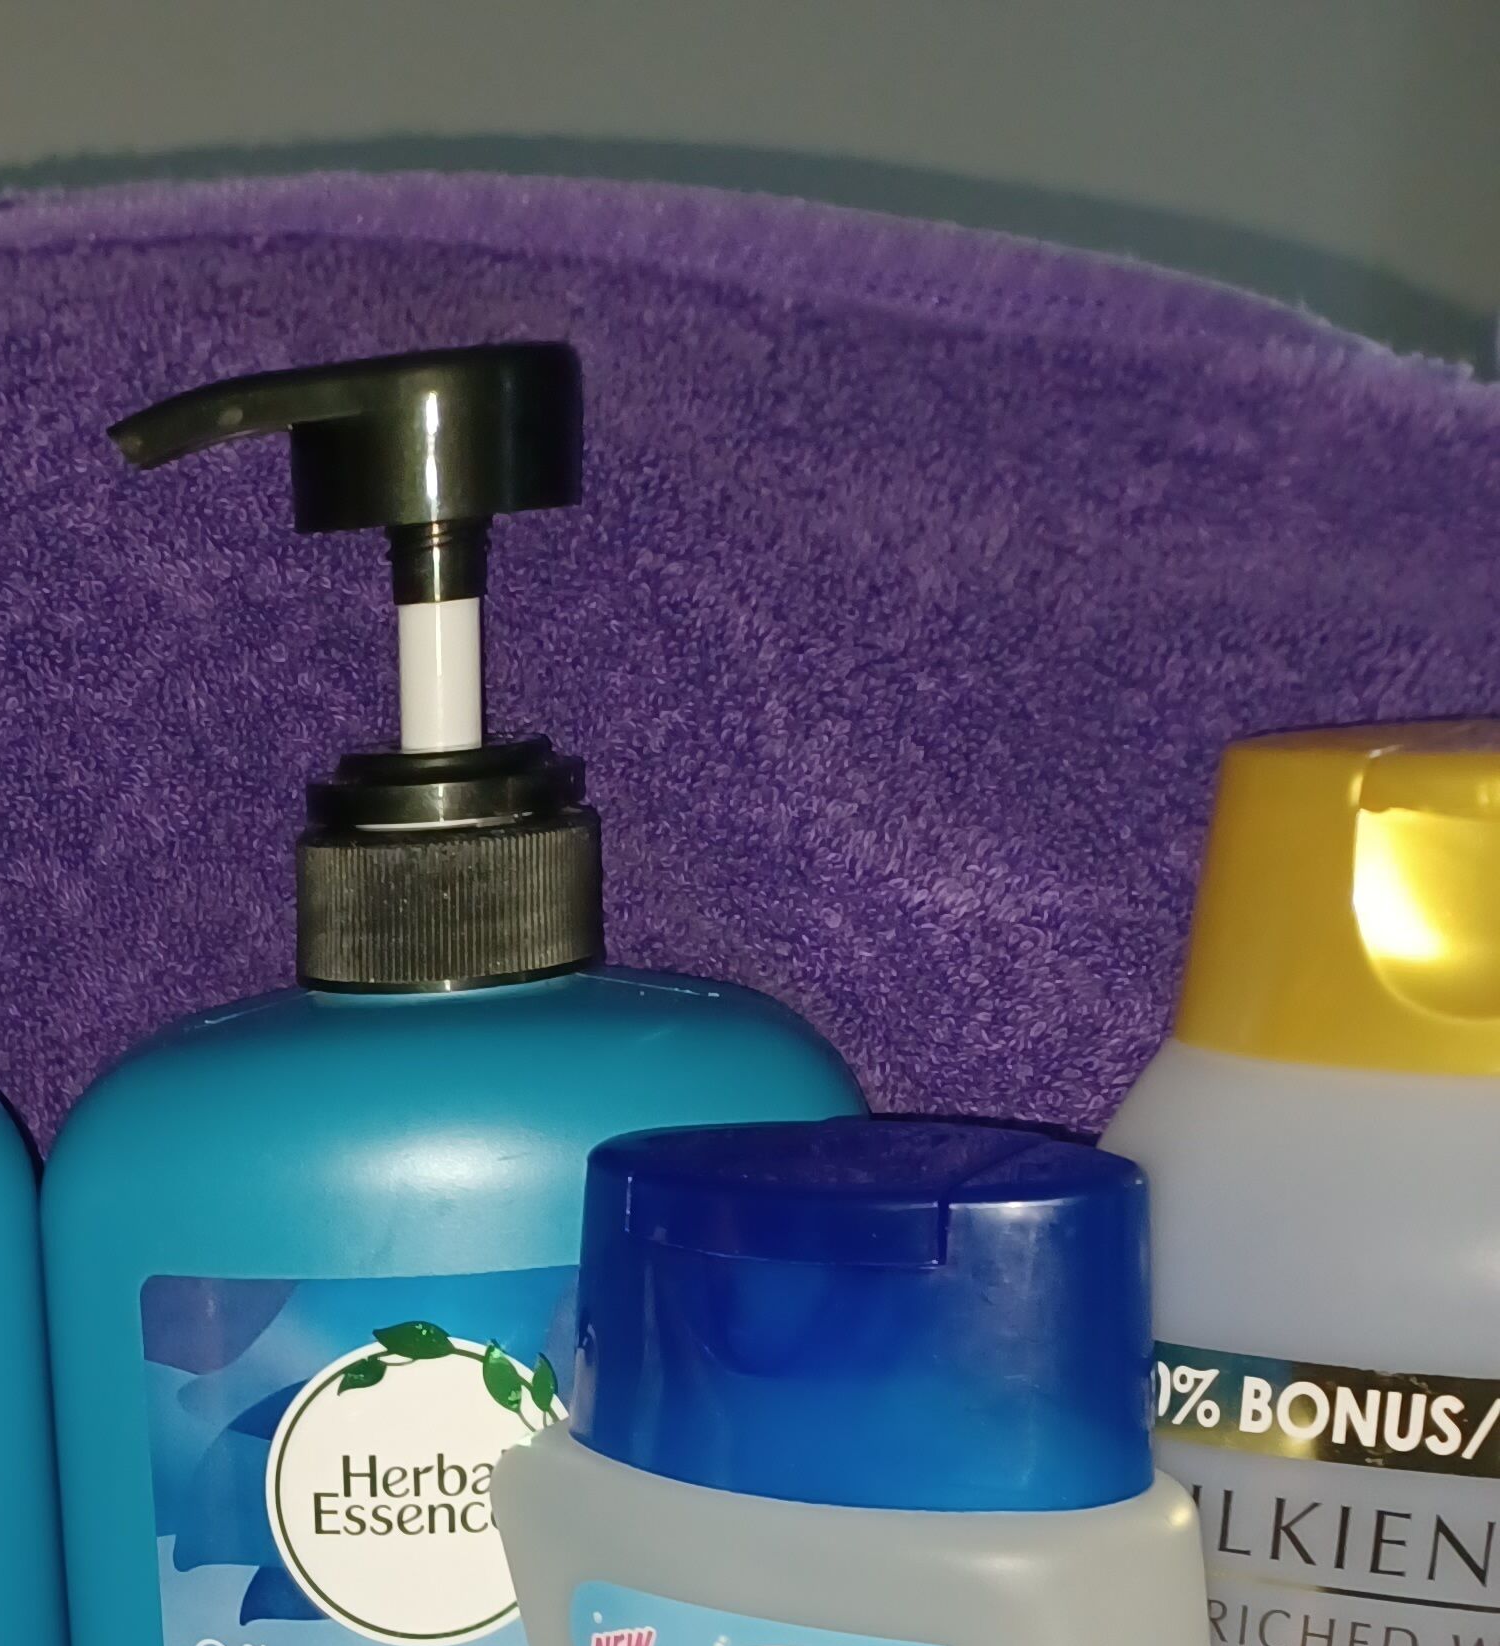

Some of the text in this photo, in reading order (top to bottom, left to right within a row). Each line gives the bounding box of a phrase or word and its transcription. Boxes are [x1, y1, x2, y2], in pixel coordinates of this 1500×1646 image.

[342, 1450, 503, 1498] Herba
[313, 1492, 499, 1536] Essenc
[1192, 1484, 1497, 1588] LKIEN
